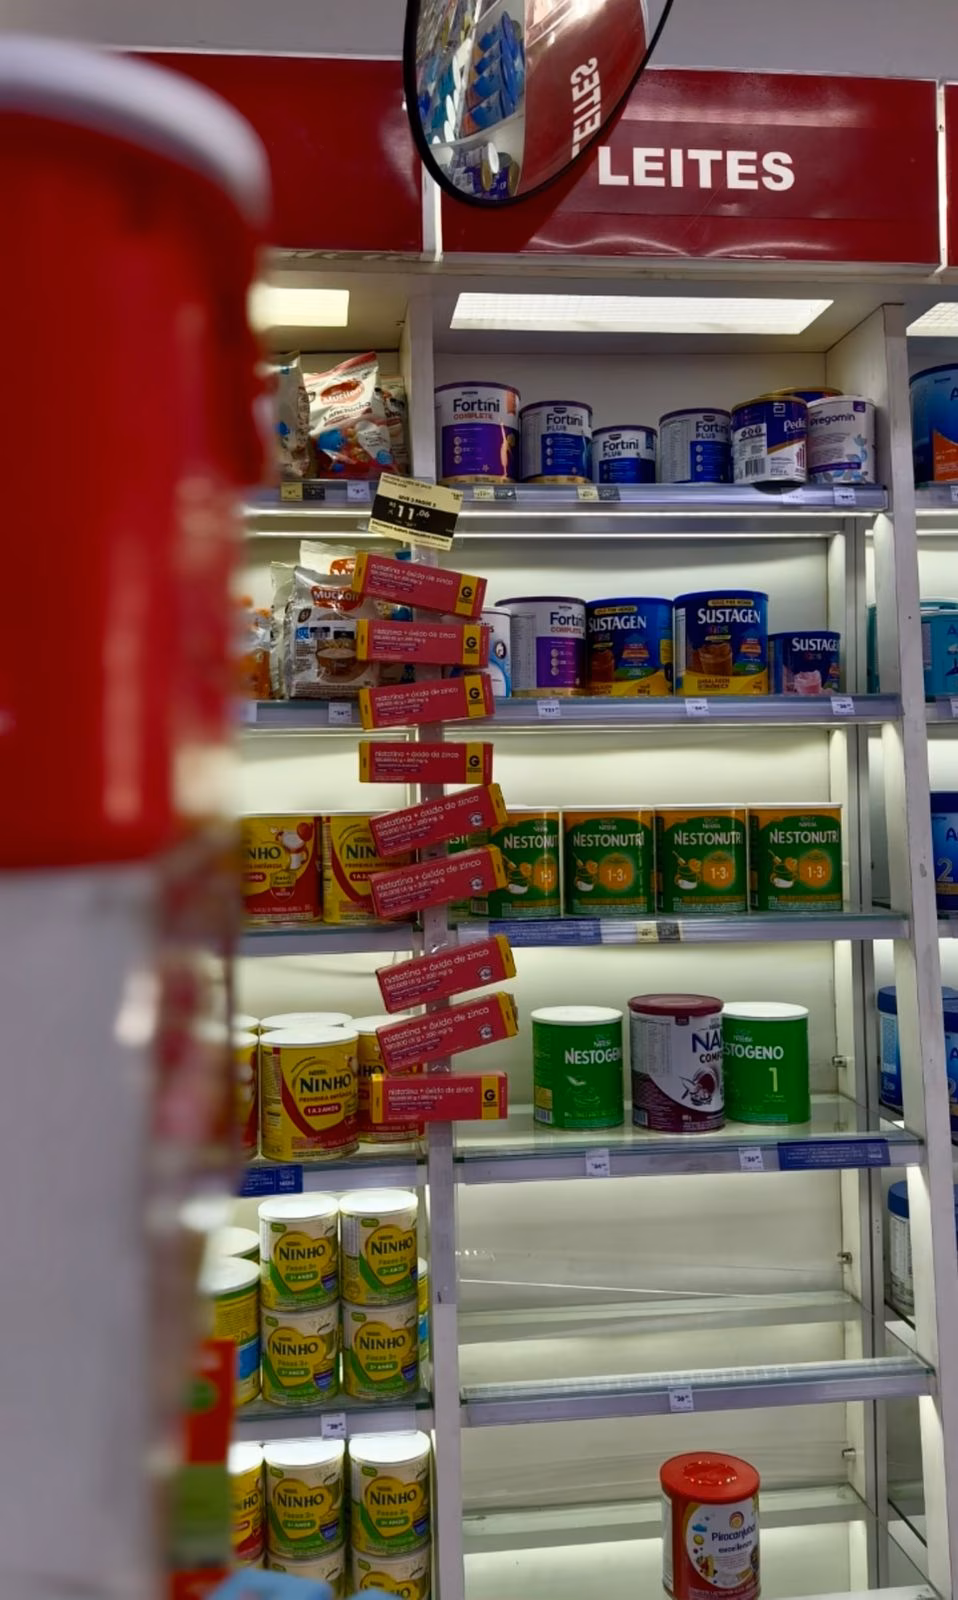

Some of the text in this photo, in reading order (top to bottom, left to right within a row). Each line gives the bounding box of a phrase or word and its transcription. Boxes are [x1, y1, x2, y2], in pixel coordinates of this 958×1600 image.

[598, 146, 795, 191] LEITES
[453, 398, 500, 412] Fortini
[546, 413, 583, 426] Fortini
[602, 440, 639, 452] Fortini
[461, 586, 472, 598] G
[588, 615, 647, 632] SUSTAGEN
[698, 608, 760, 624] SUSTAGEN
[466, 636, 477, 648] G
[468, 687, 480, 699] G
[468, 755, 480, 768] G
[573, 832, 644, 847] NESTONUTRI
[248, 846, 281, 859] NHO
[346, 844, 376, 859] NIN
[446, 865, 458, 874] de
[459, 860, 482, 870] zinco
[937, 858, 954, 882] 2
[383, 968, 422, 984] nistatina
[429, 960, 453, 972] óxido
[454, 956, 465, 964] de
[467, 949, 489, 961] zinco
[383, 1028, 421, 1044] nistatina
[429, 1018, 453, 1030] óxido
[454, 1014, 465, 1022] de
[467, 1007, 490, 1019] zinco
[722, 1042, 784, 1060] STOGENO
[300, 1074, 352, 1094] NINHO
[768, 1067, 778, 1092] 1
[484, 1089, 495, 1102] G
[279, 1244, 325, 1260] NINHO
[371, 1236, 413, 1256] NINHO
[272, 1342, 318, 1356] NINHO
[360, 1335, 406, 1350] NINHO
[277, 1494, 324, 1508] NINHO
[370, 1489, 417, 1506] NINHO
